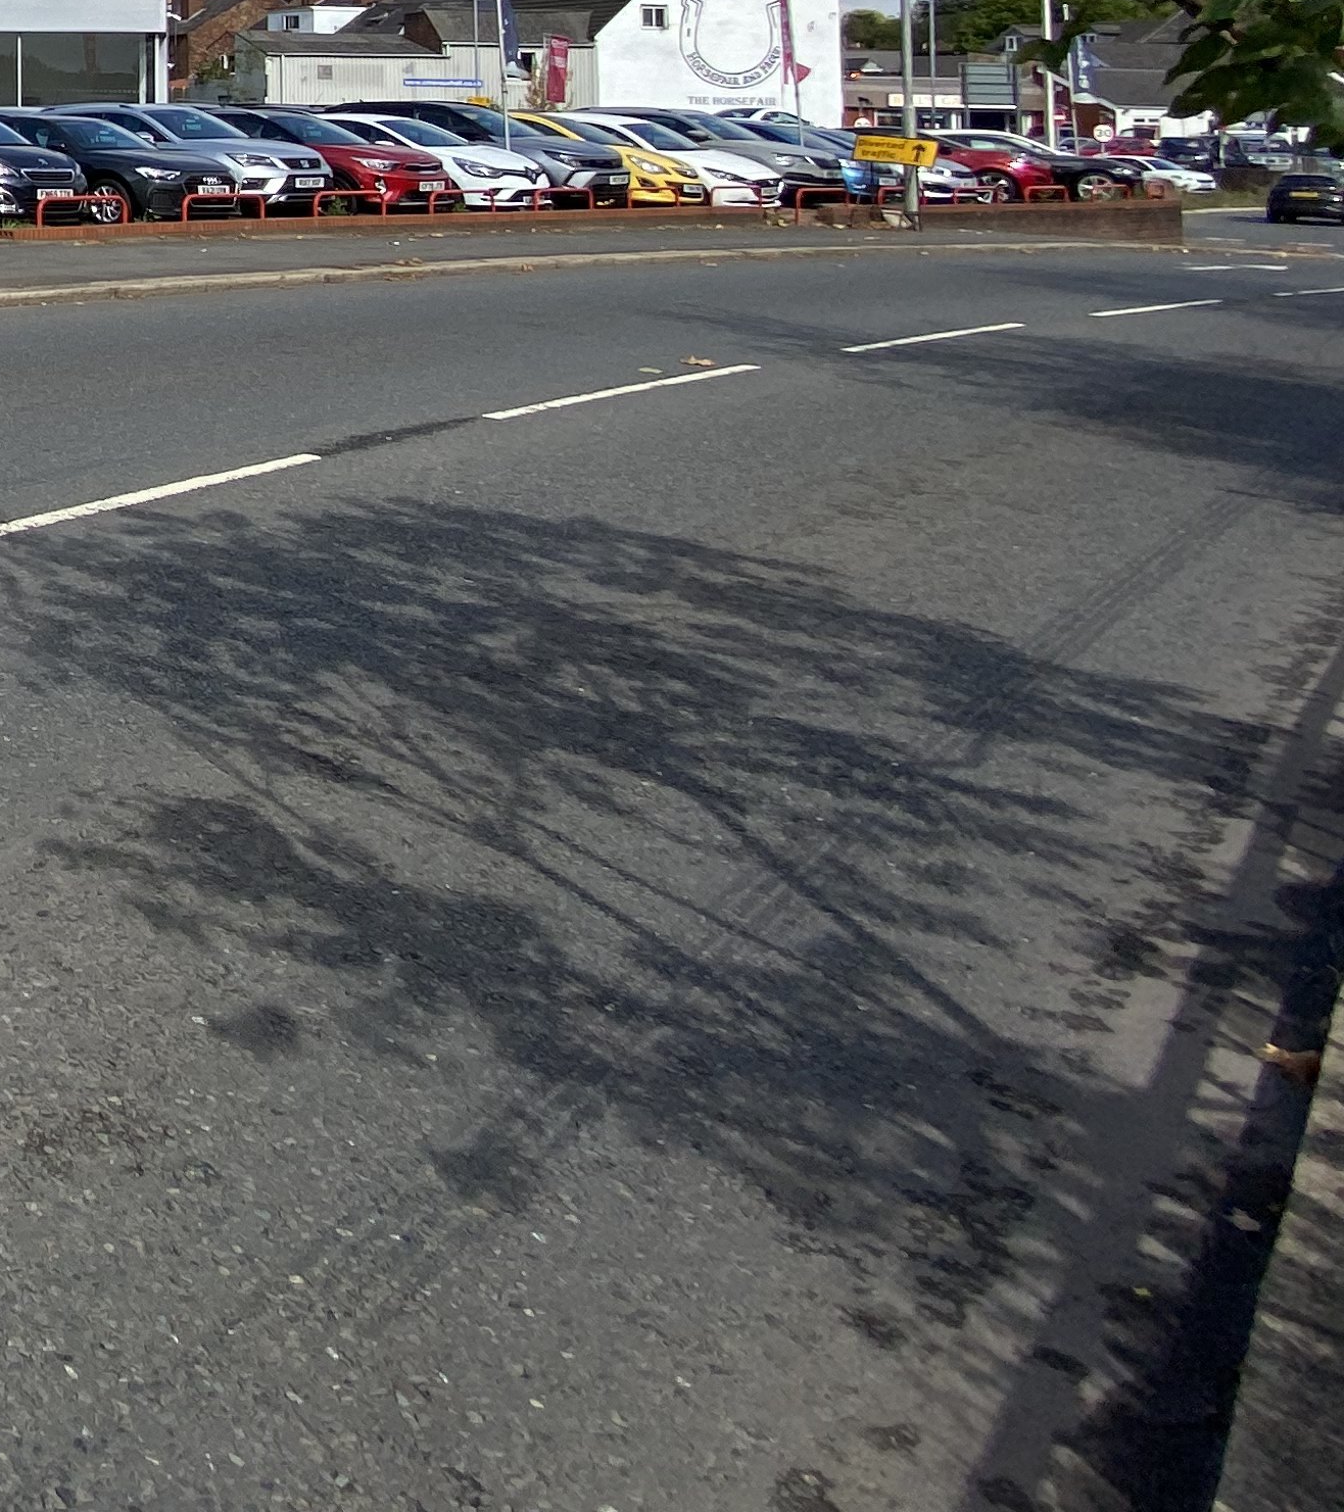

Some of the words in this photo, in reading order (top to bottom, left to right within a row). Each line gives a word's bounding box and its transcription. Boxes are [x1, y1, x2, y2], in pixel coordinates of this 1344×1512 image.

[687, 95, 710, 106] THE
[712, 96, 777, 107] HORSEFAIR
[1095, 129, 1111, 138] 30
[858, 139, 906, 150] Diverted
[861, 149, 897, 160] traffic
